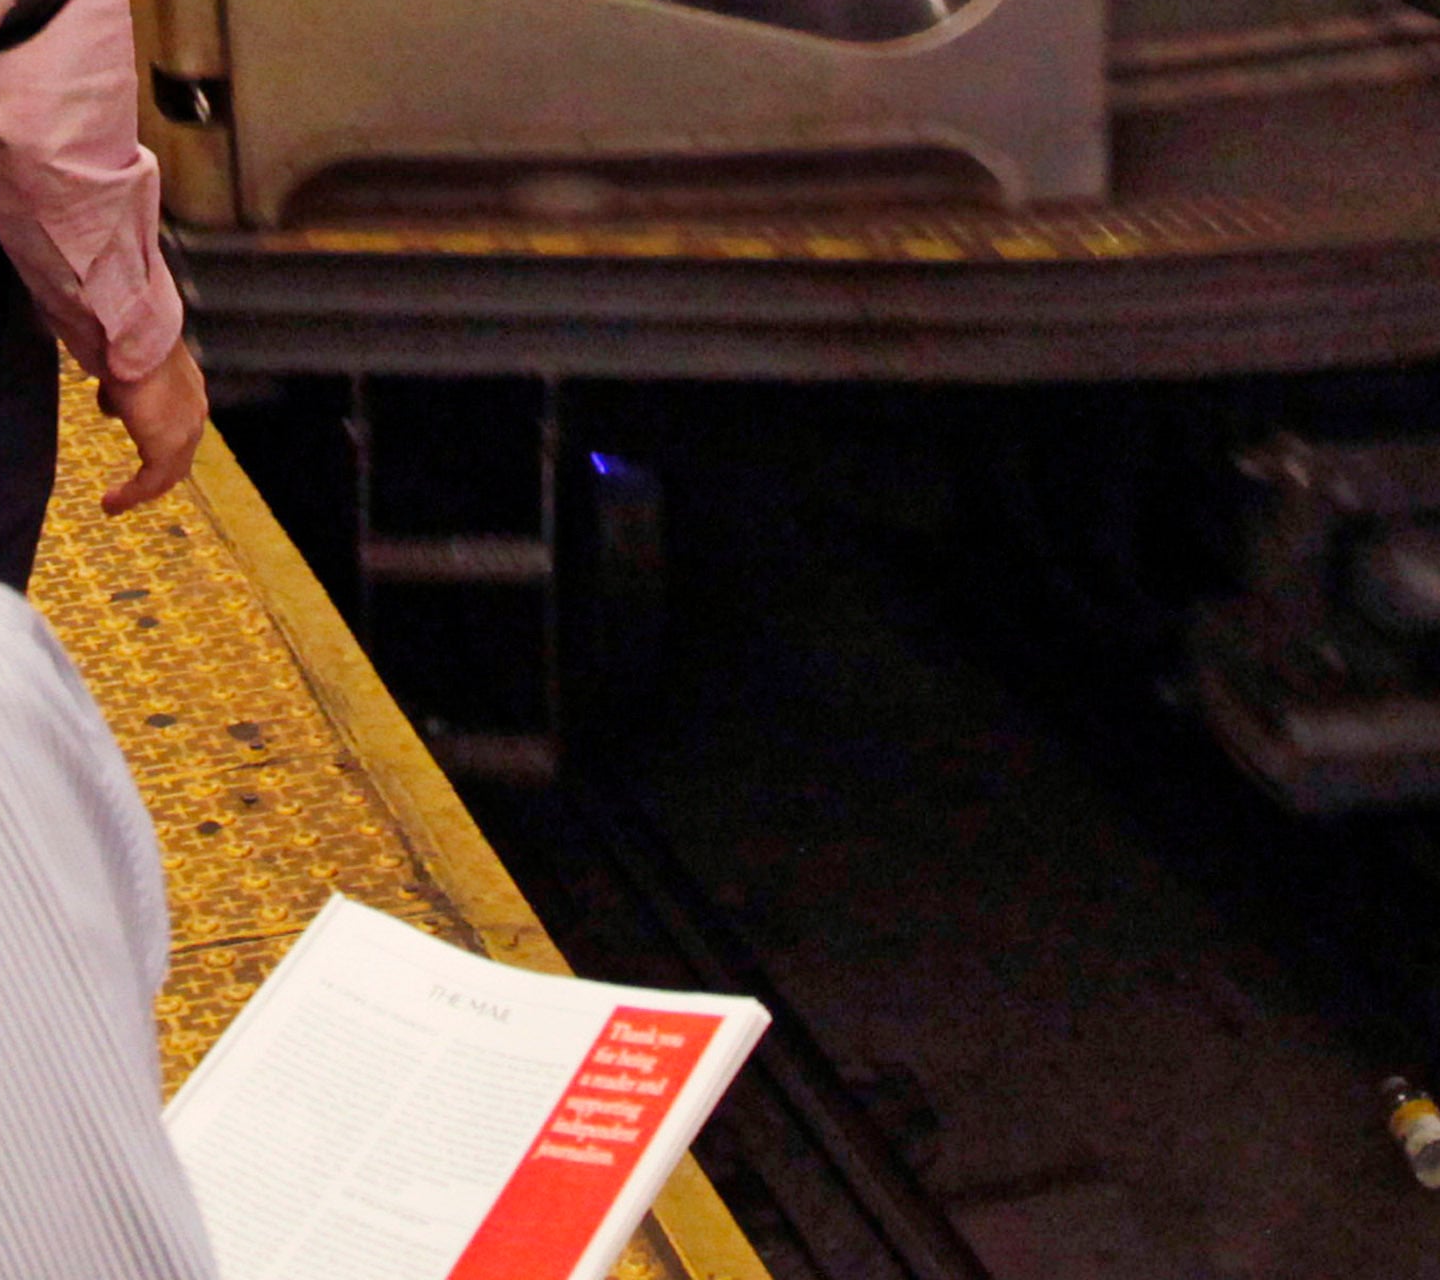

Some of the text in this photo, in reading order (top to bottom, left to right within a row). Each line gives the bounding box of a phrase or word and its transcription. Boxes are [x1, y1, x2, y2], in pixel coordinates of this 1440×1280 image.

[609, 1020, 686, 1051] Thank you
[593, 1046, 659, 1074] for being
[579, 1072, 591, 1087] a
[636, 1077, 669, 1096] and
[565, 1096, 645, 1124] supporting
